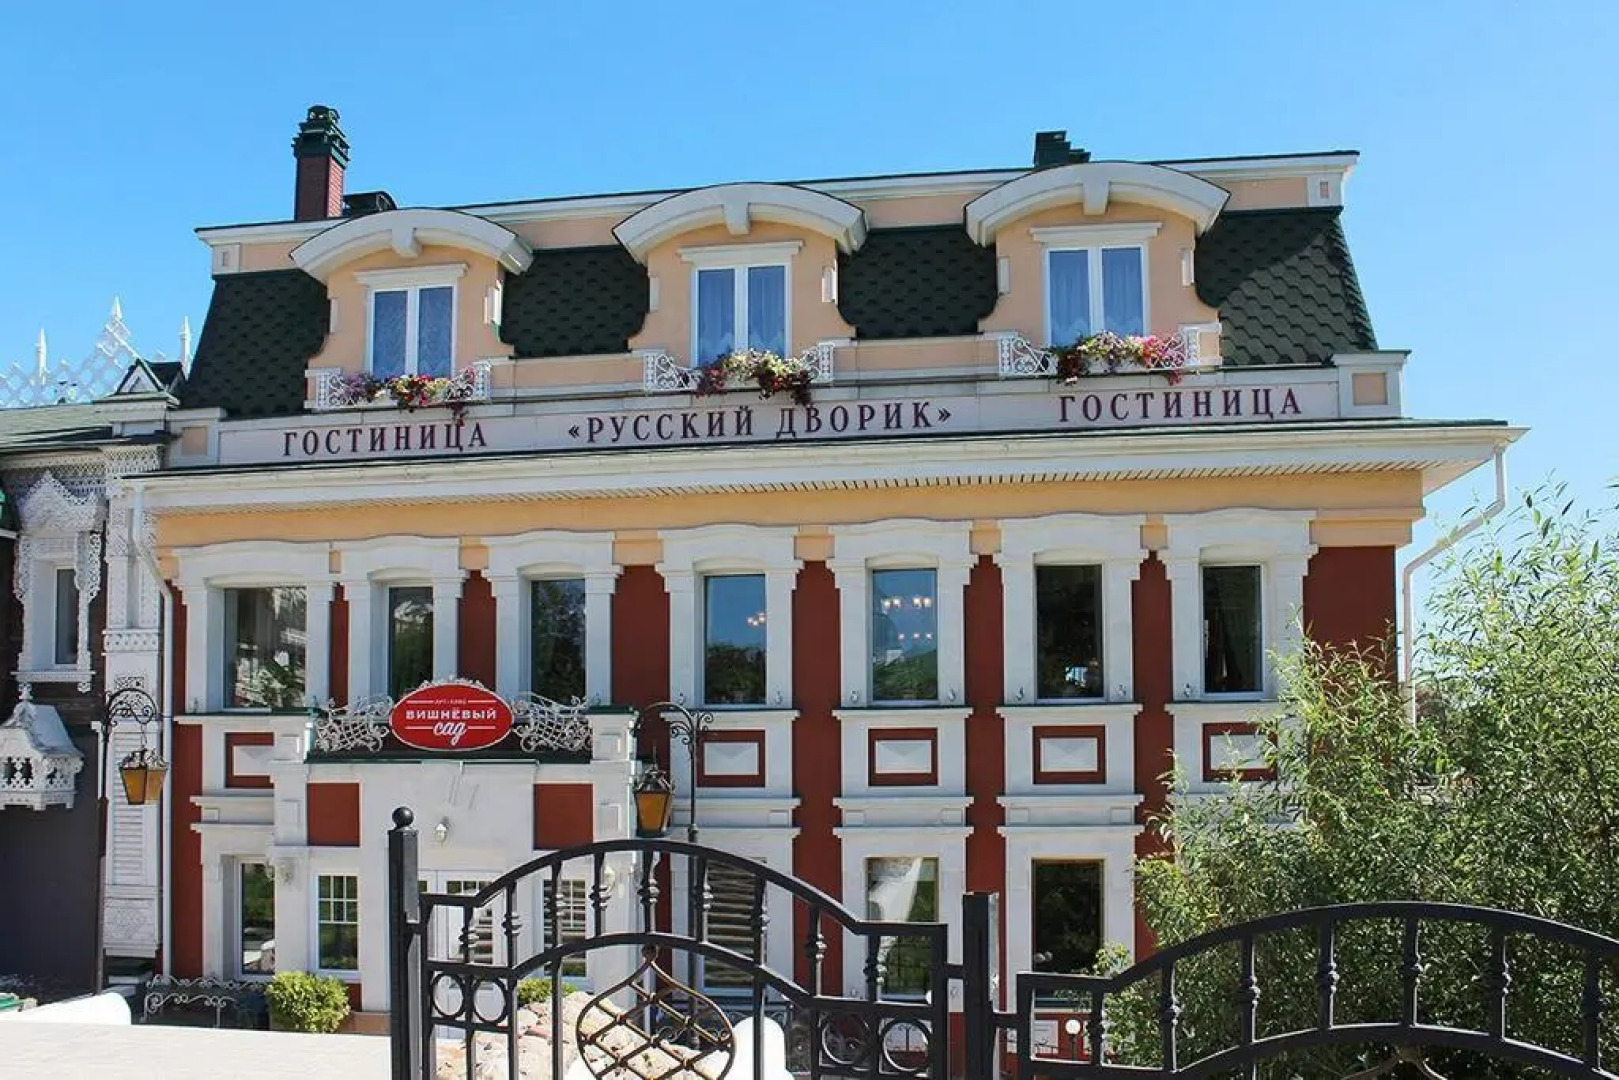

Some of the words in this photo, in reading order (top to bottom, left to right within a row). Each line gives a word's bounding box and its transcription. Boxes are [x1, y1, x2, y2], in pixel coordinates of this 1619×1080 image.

[568, 405, 754, 443] «РУССКИЙ
[776, 400, 951, 439] ДВОРИК»
[1059, 388, 1302, 422] ГОСТИНИЦА
[284, 421, 487, 456] ГОСТИНИЦА
[405, 707, 497, 720] ВИШНЁВЫЙ
